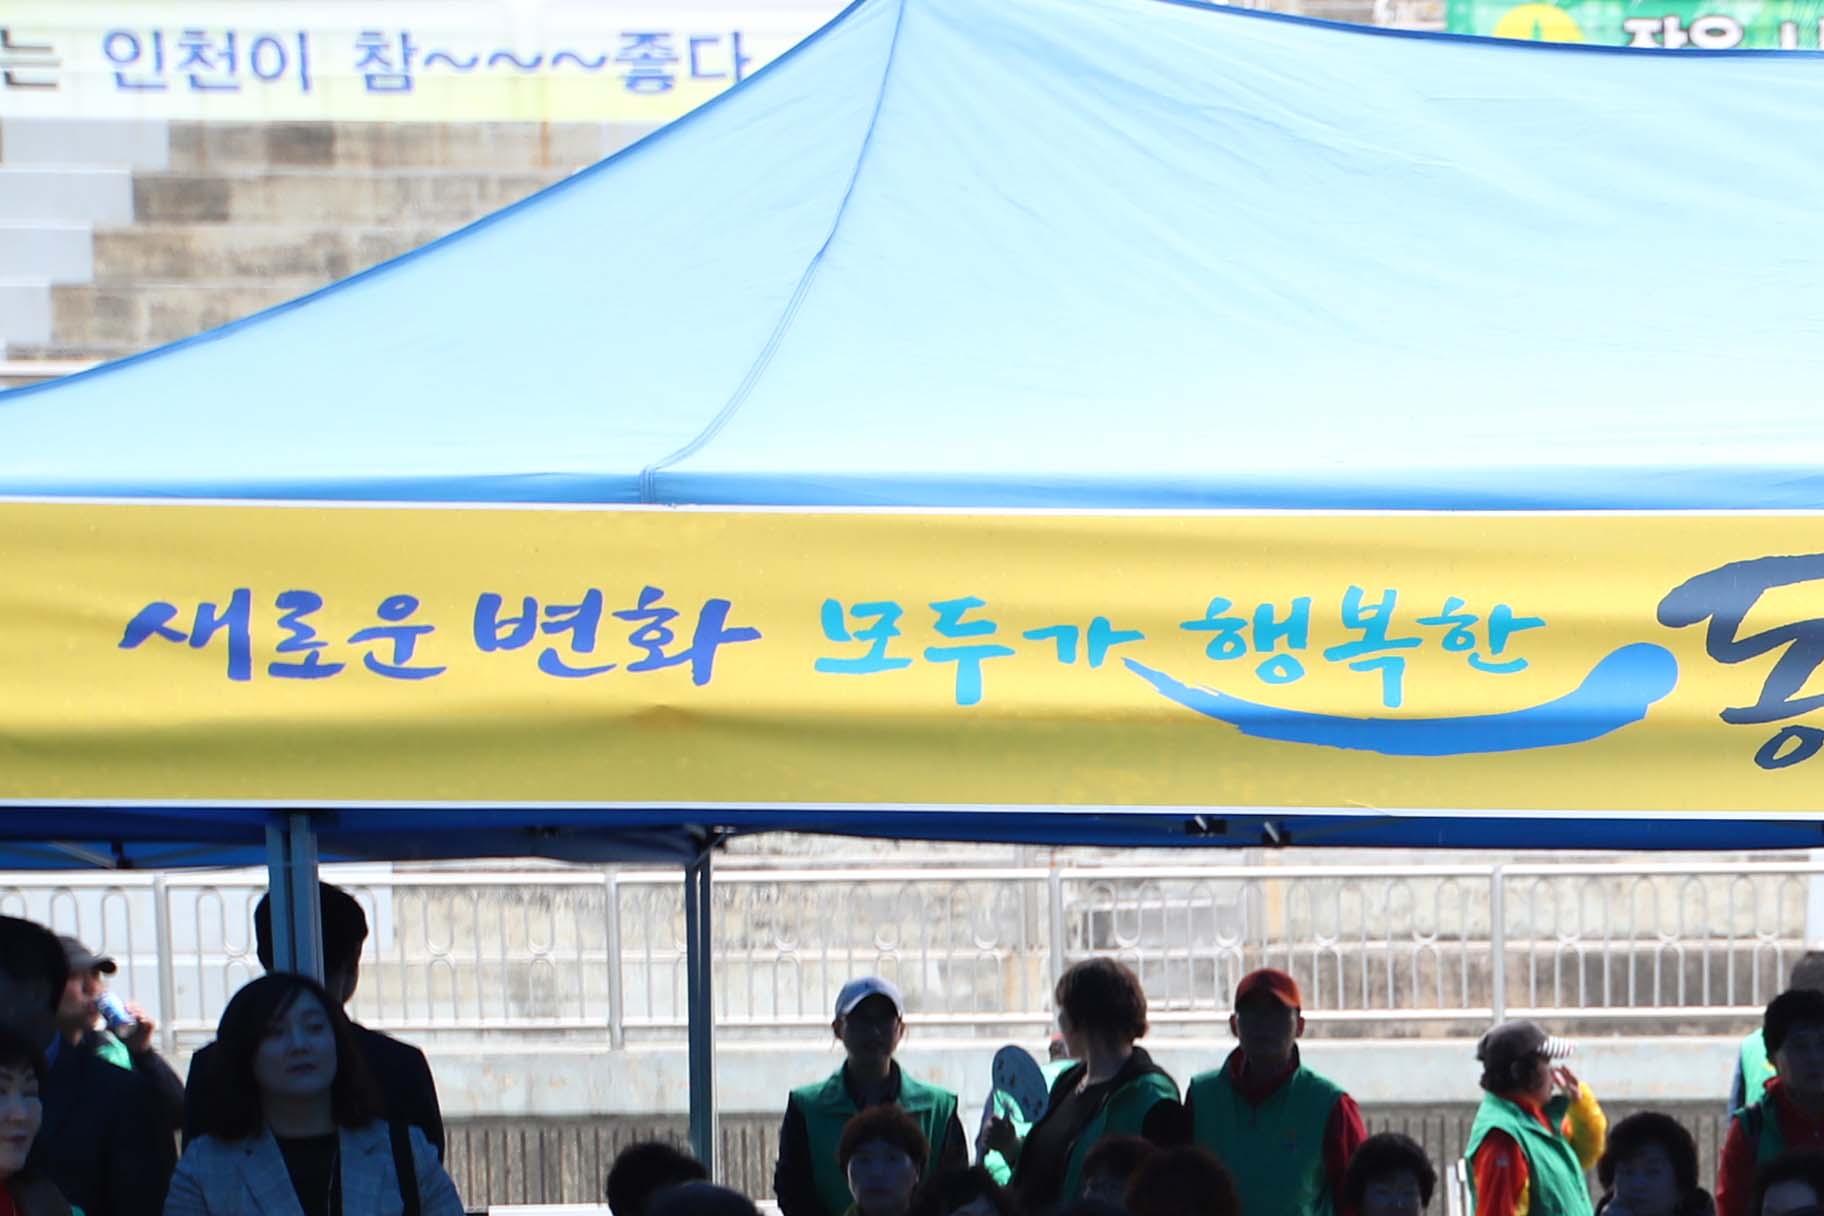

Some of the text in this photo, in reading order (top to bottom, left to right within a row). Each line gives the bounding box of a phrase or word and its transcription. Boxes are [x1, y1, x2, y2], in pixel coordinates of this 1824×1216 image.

[101, 28, 311, 93] 인천이
[119, 587, 446, 682] 새로운
[473, 586, 762, 686] 변화
[814, 596, 1146, 706] 모두가
[1180, 585, 1546, 707] 행복한
